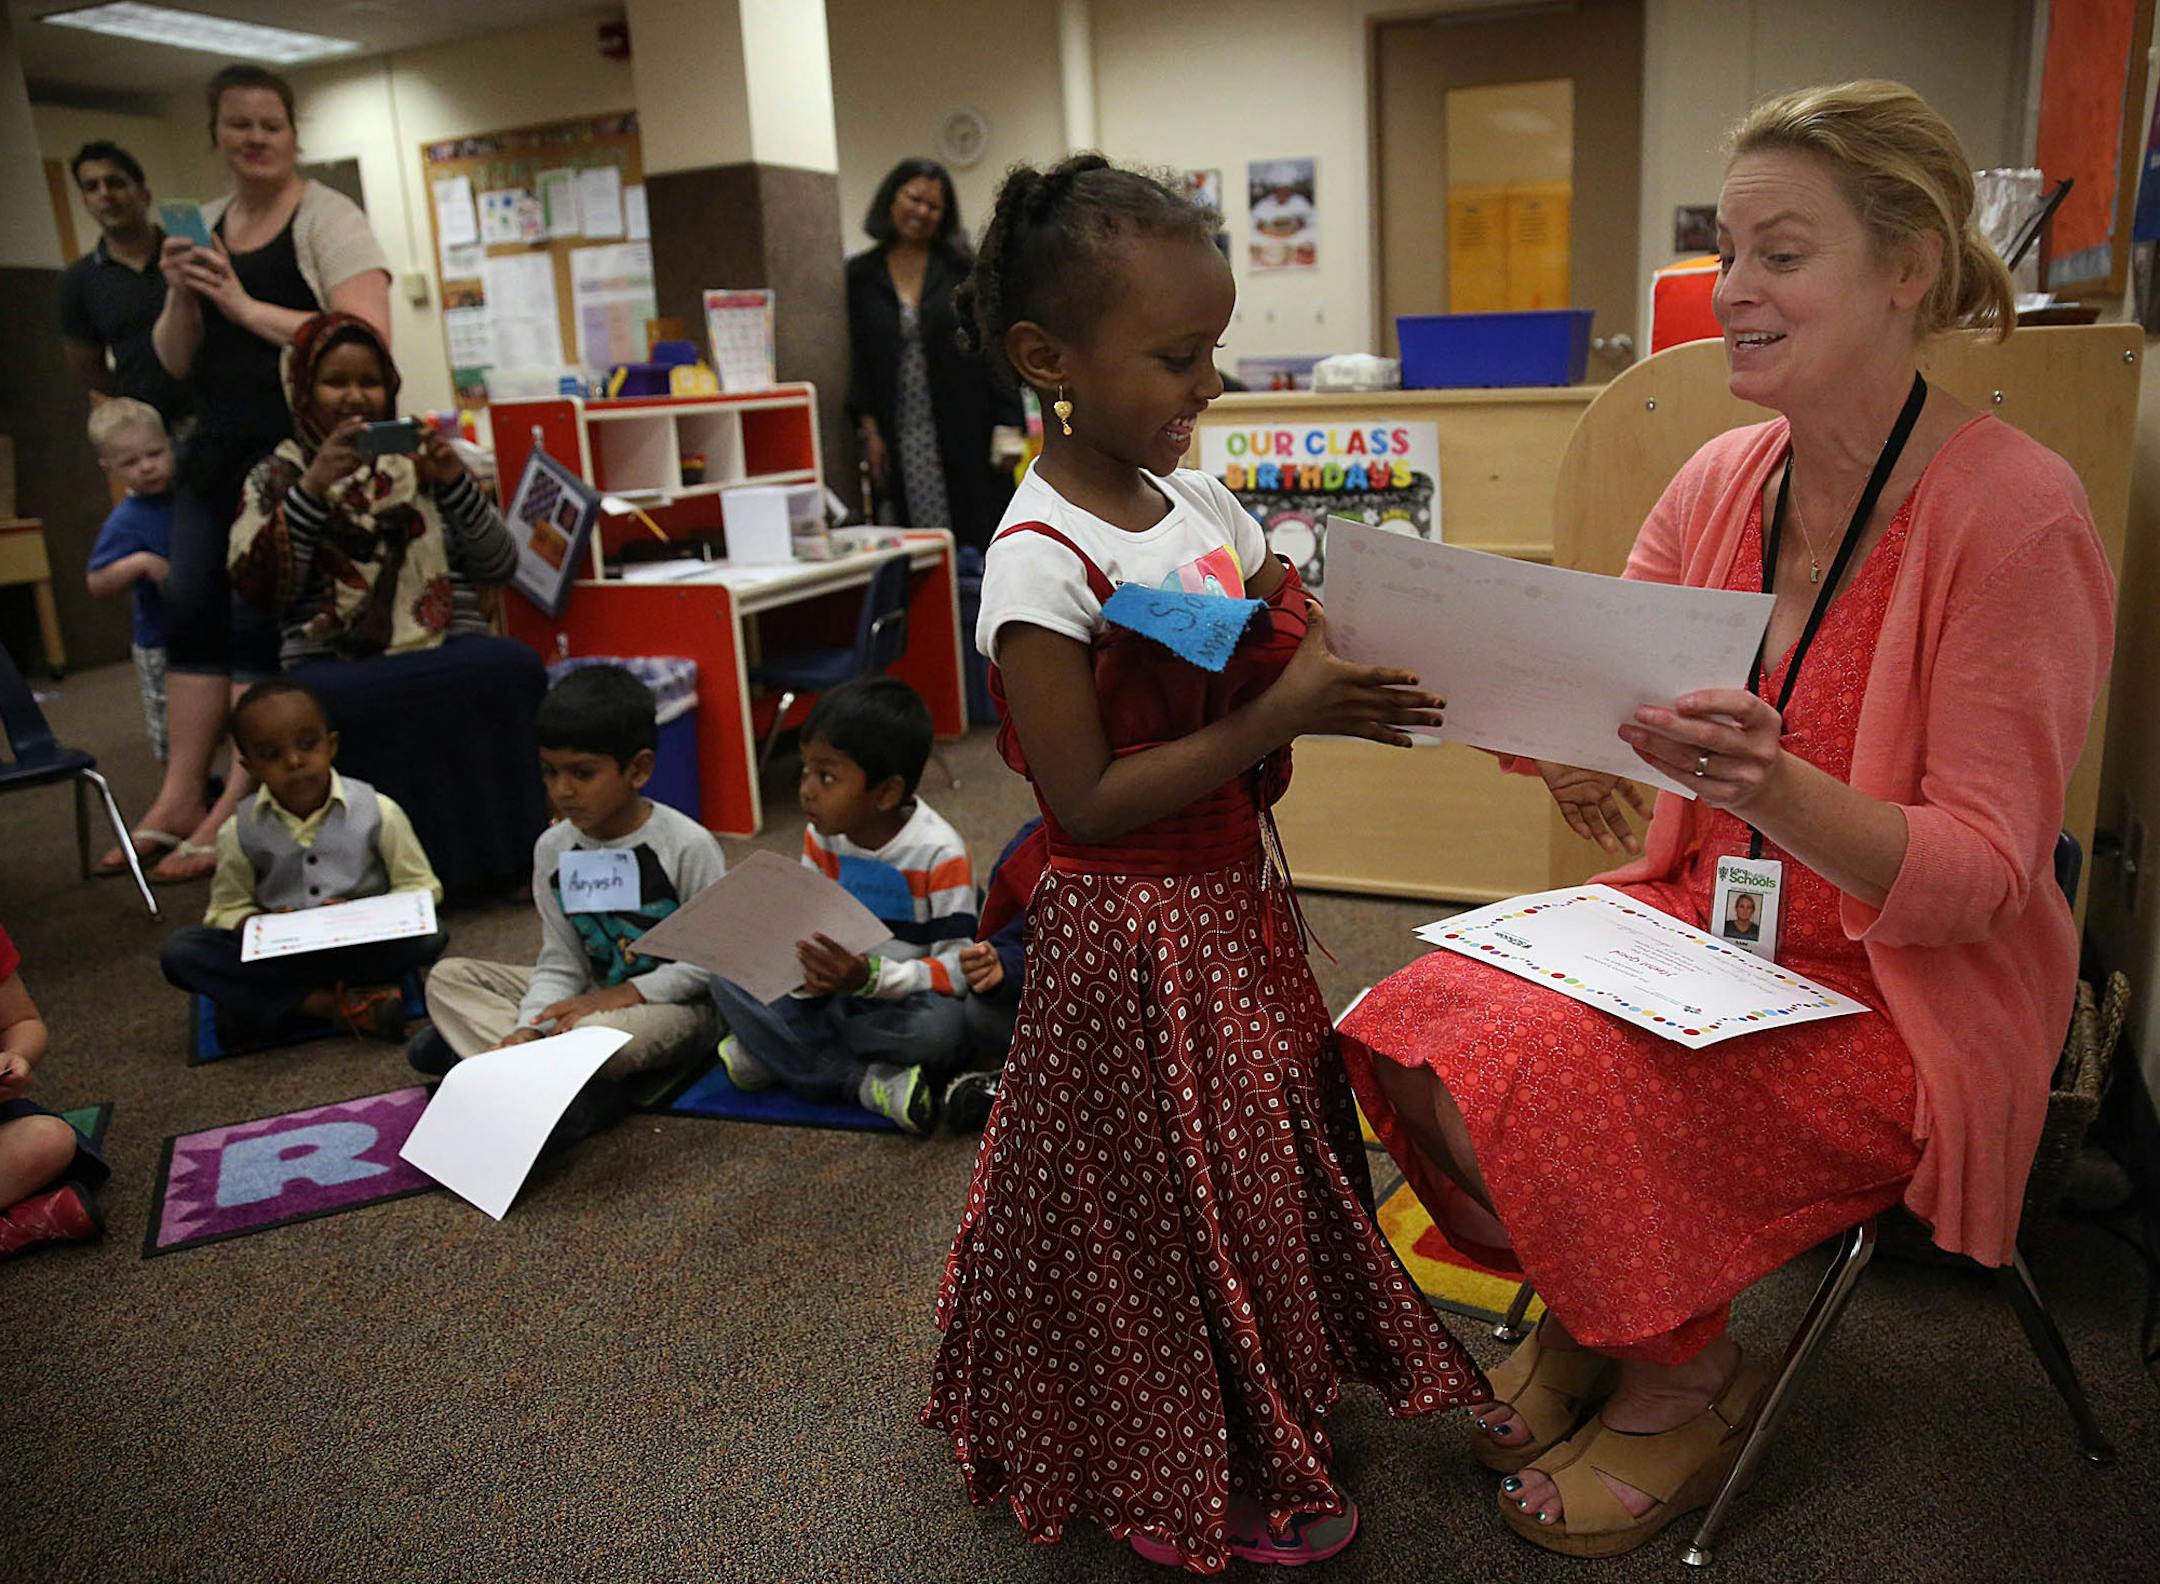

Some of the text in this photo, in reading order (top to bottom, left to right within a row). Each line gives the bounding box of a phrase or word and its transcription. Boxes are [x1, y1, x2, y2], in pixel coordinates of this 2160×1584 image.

[1226, 428, 1411, 457] OUR CLASS
[1226, 459, 1413, 491] BIRTHDAYS
[1729, 872, 1777, 888] Schools
[216, 1121, 390, 1208] R
